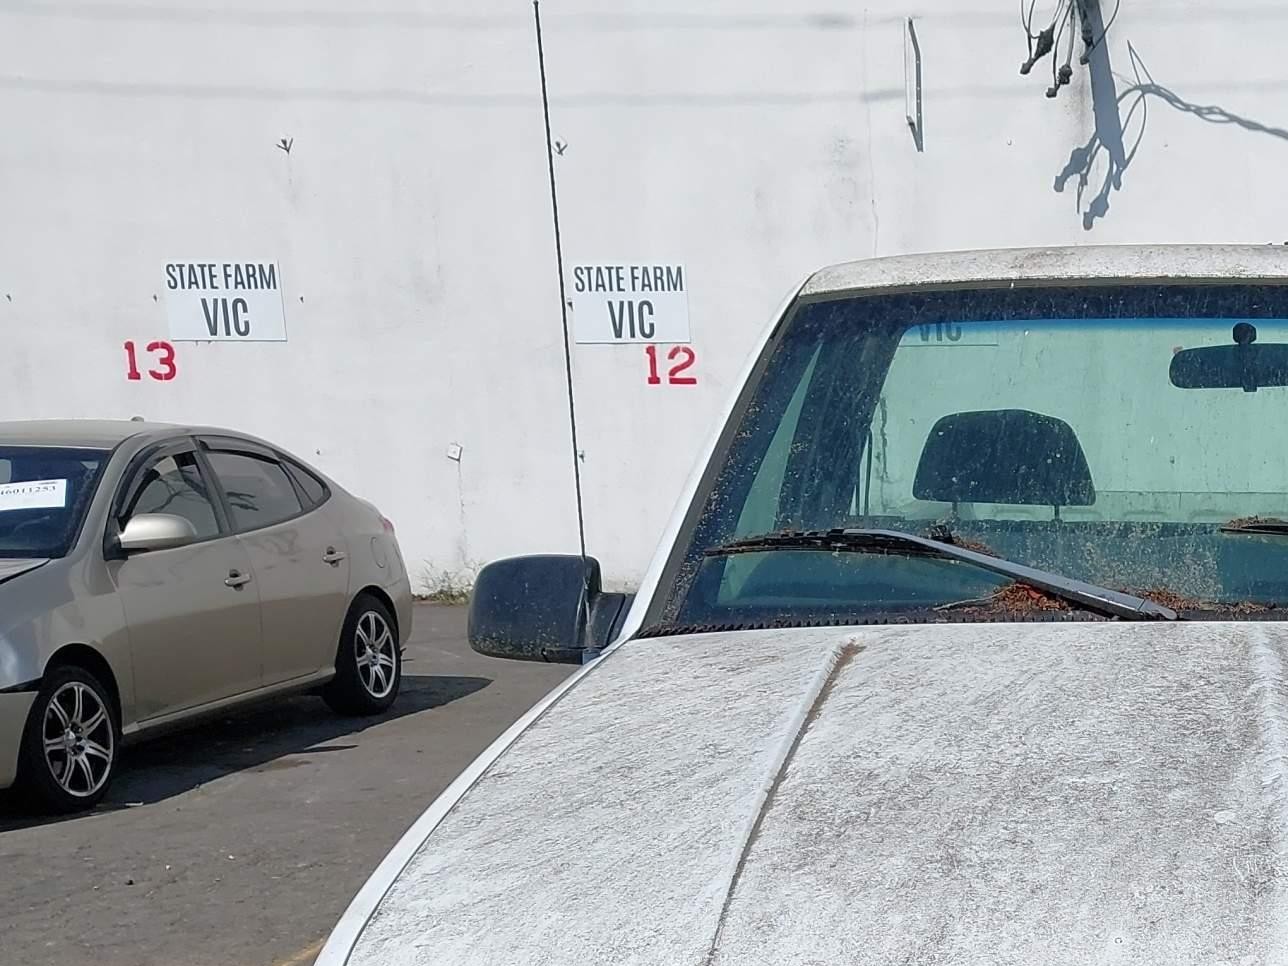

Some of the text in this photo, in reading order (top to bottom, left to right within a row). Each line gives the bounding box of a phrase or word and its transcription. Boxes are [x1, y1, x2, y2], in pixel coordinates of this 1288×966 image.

[165, 263, 277, 290] STATE FARM
[574, 266, 684, 293] STATE FARM
[201, 297, 250, 337] VIC
[607, 300, 655, 339] VIC
[126, 342, 177, 382] 13
[646, 345, 697, 386] 12
